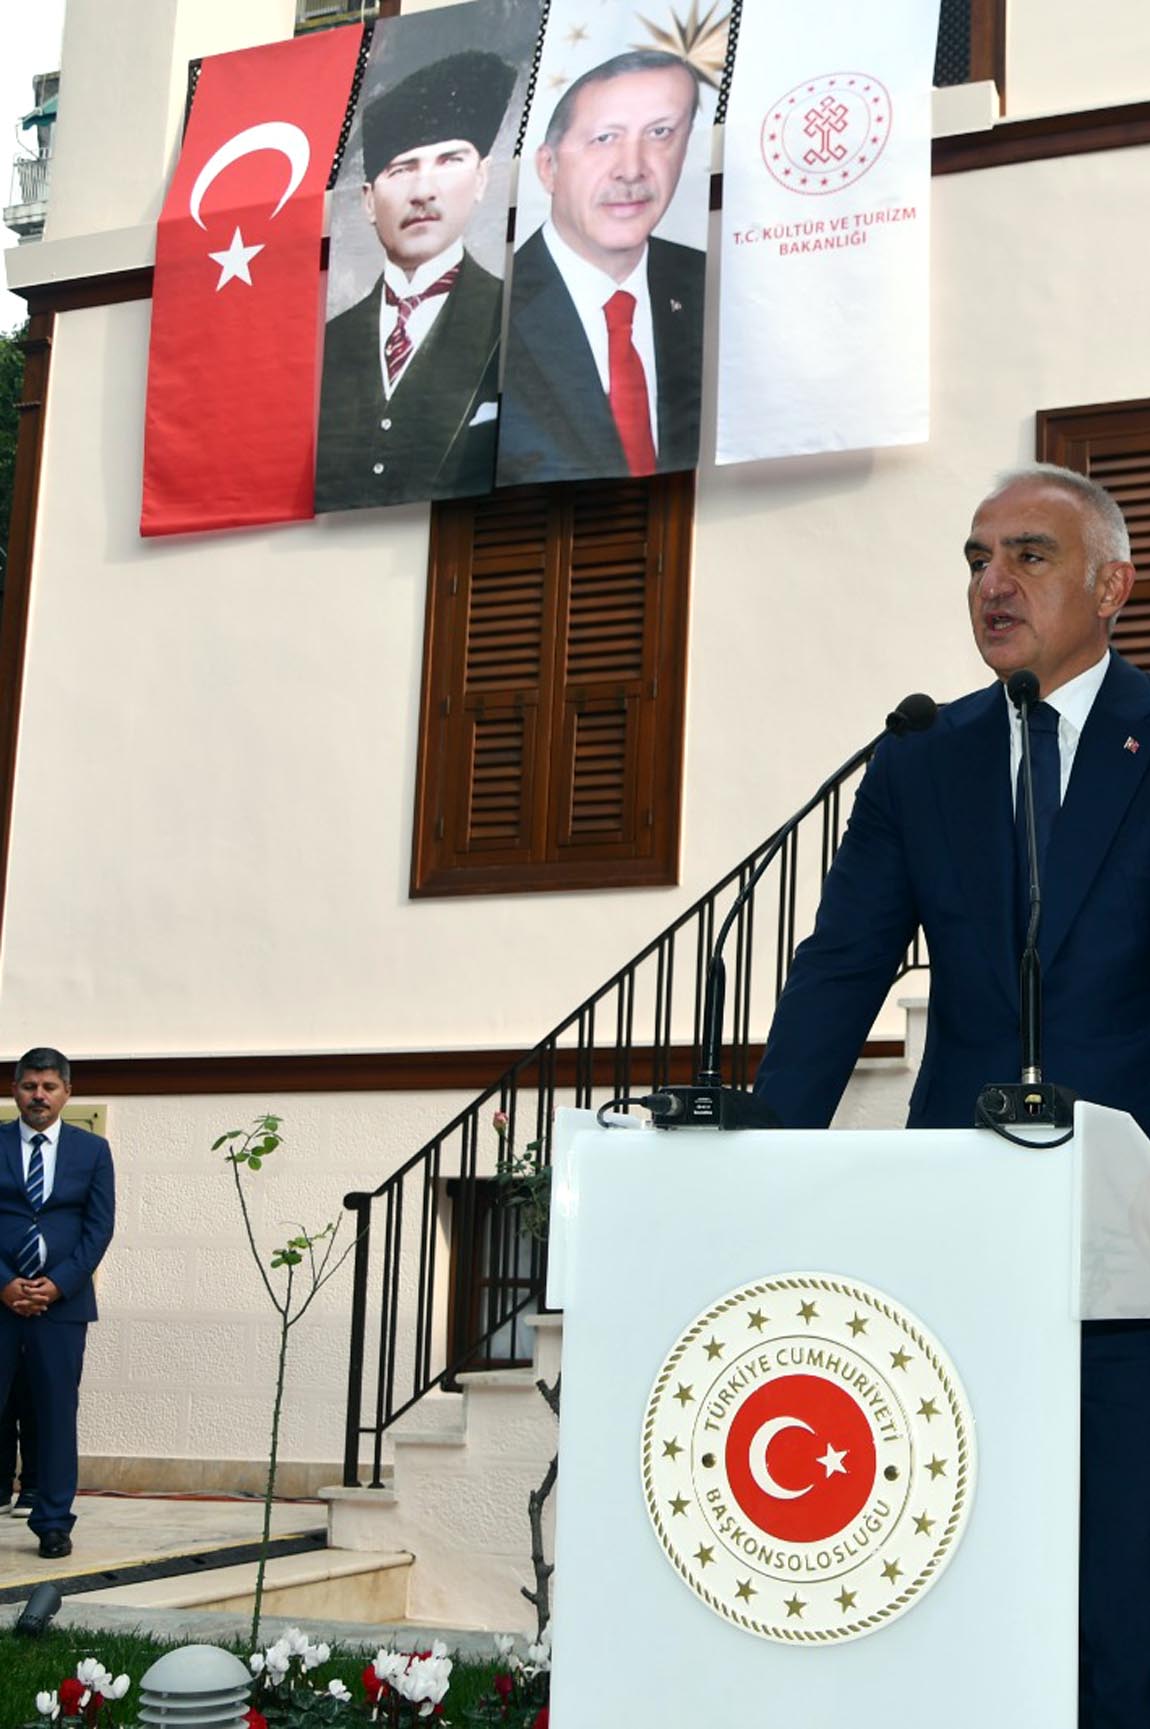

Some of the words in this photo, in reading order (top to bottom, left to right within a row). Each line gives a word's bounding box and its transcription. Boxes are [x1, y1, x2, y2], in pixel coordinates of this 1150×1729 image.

[733, 229, 758, 246] T.C.
[763, 219, 825, 241] KÜLTÜR
[830, 216, 850, 232] VE
[854, 206, 917, 228] TURİZM
[779, 230, 868, 256] BAKANLIĞI
[704, 1354, 772, 1433] TÜRKİYE
[776, 1347, 904, 1442] CUMHURİYETİ
[706, 1488, 891, 1572] BAŞKONSOLOSLUĞU
